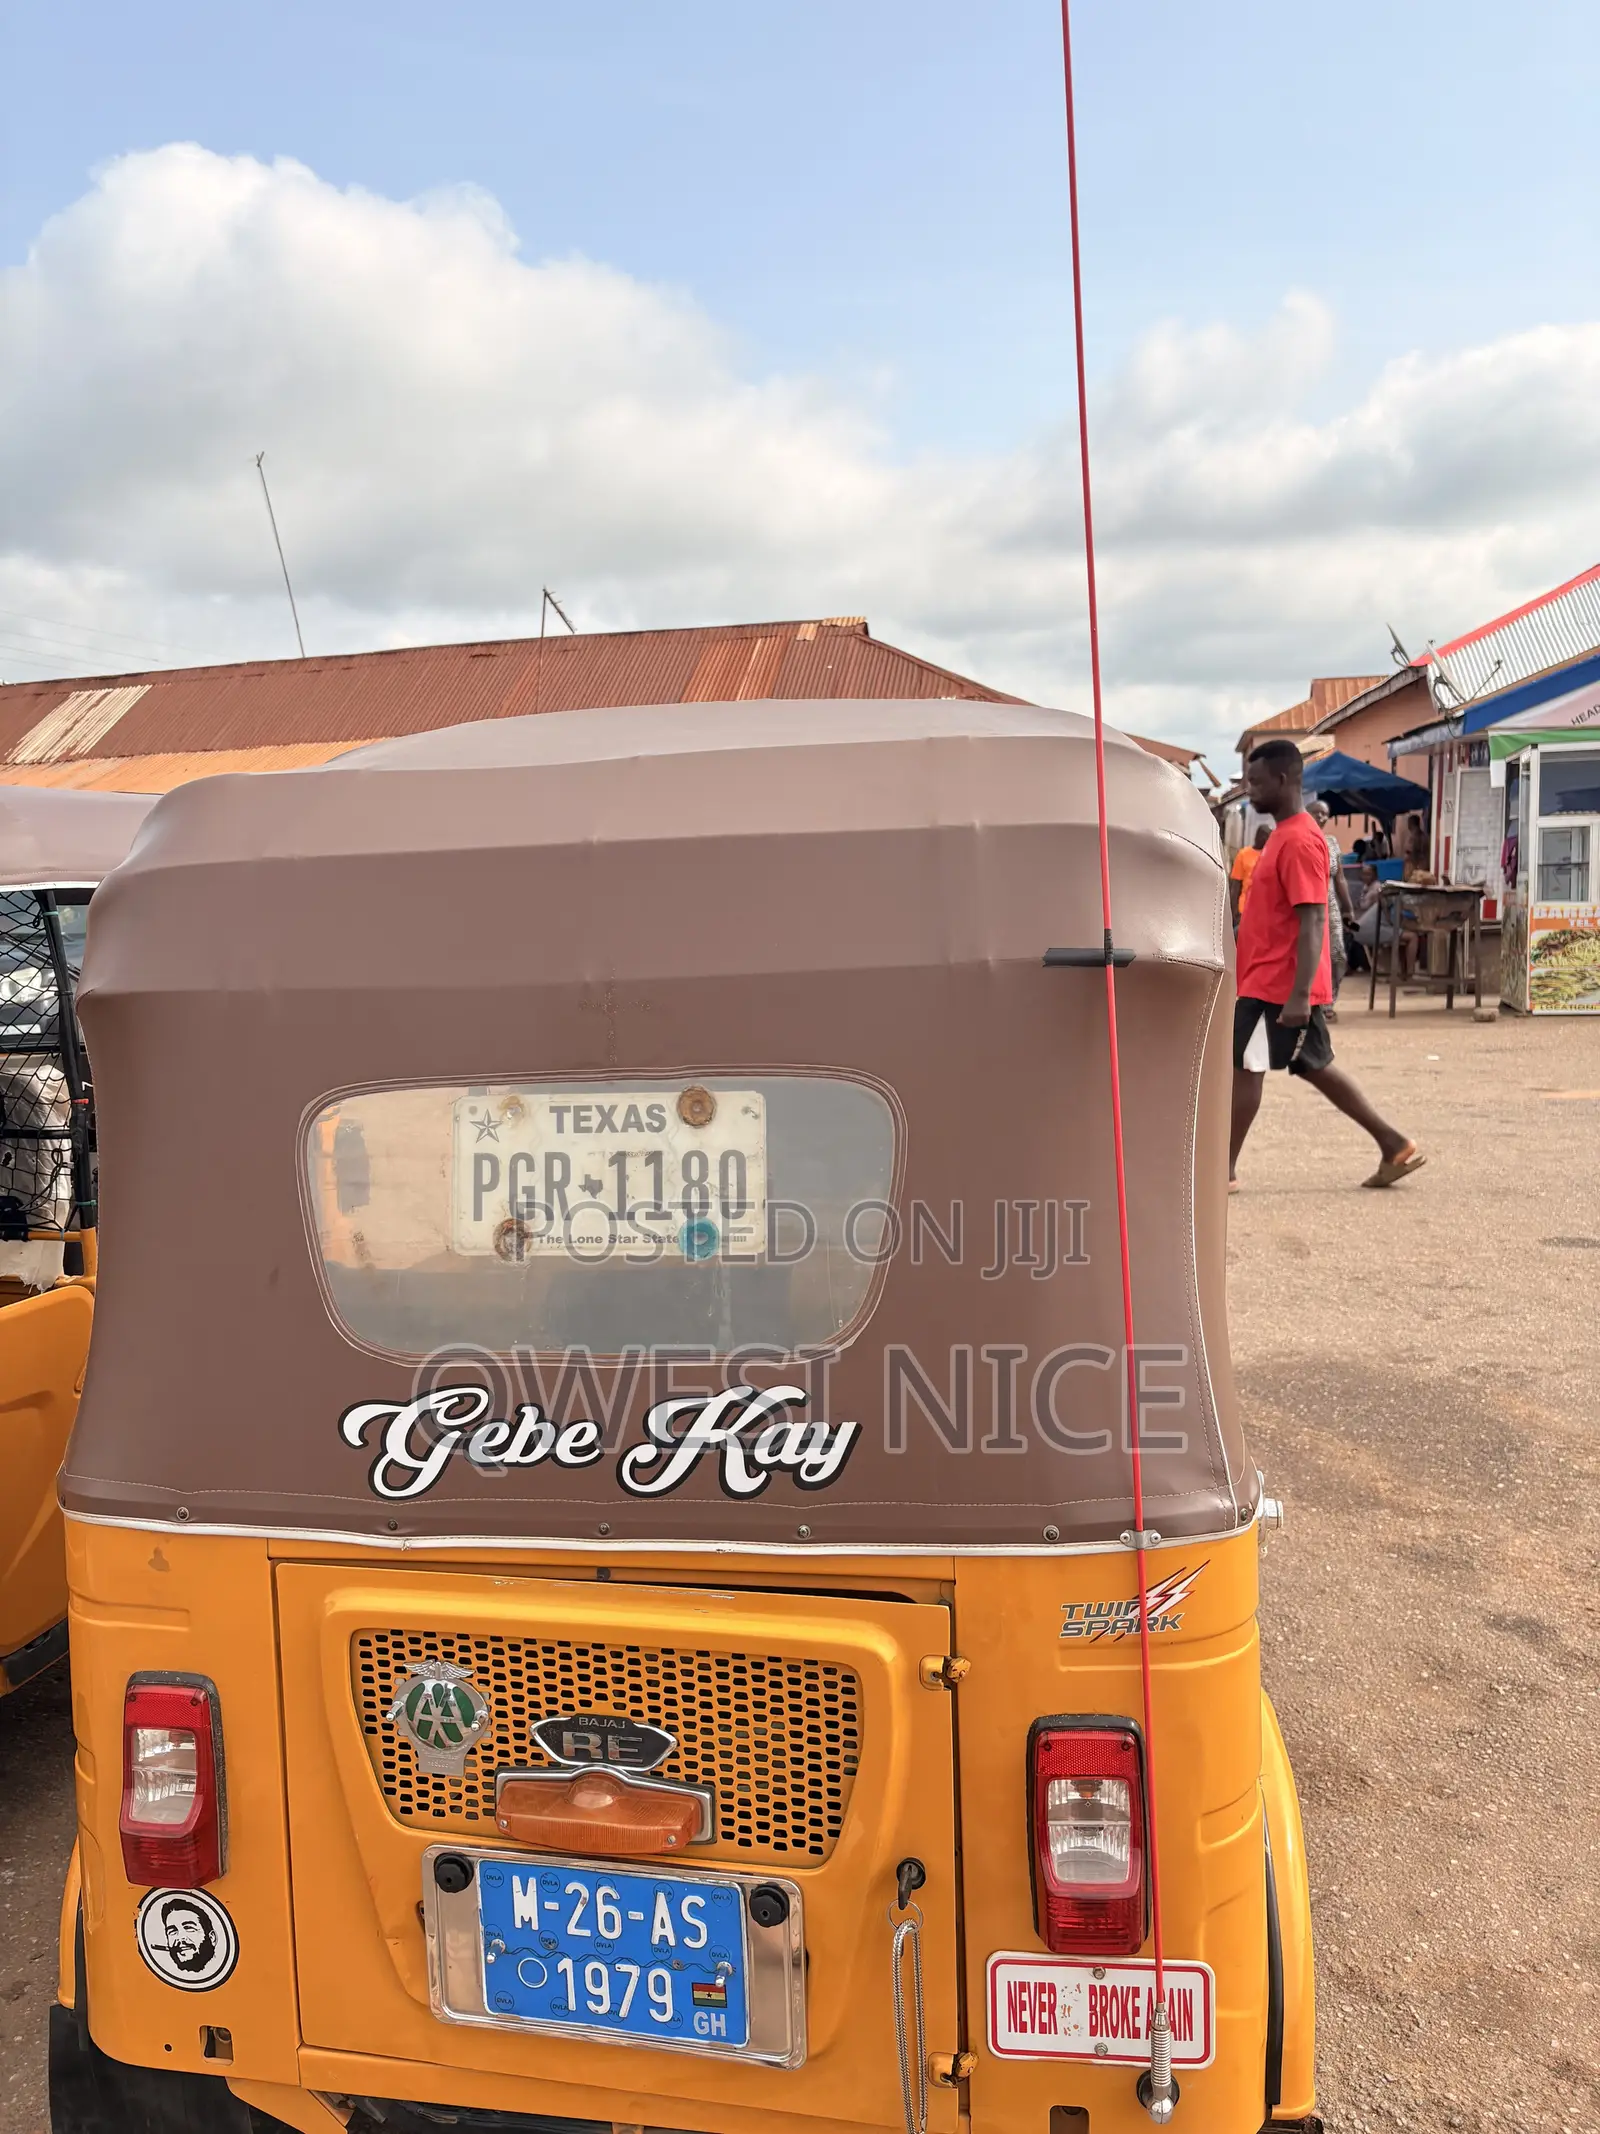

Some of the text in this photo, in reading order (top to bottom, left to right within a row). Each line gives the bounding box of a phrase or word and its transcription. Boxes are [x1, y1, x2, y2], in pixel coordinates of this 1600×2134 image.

[549, 1103, 667, 1134] TEXAS
[473, 1149, 746, 1222] PGR 1180
[538, 1233, 680, 1244] The Lone Star State
[338, 1384, 862, 1500] Gebe Kay
[1059, 1612, 1185, 1638] SPARK
[578, 1717, 626, 1729] BAJAJ
[562, 1731, 643, 1763] RE
[512, 1875, 708, 1949] M-26-AS
[557, 1957, 674, 2023] 1979
[693, 2011, 727, 2037] GH
[1007, 1981, 1058, 2035] NEVER
[1088, 1984, 1141, 2040] BROKE
[1145, 1987, 1194, 2042] AAIN
